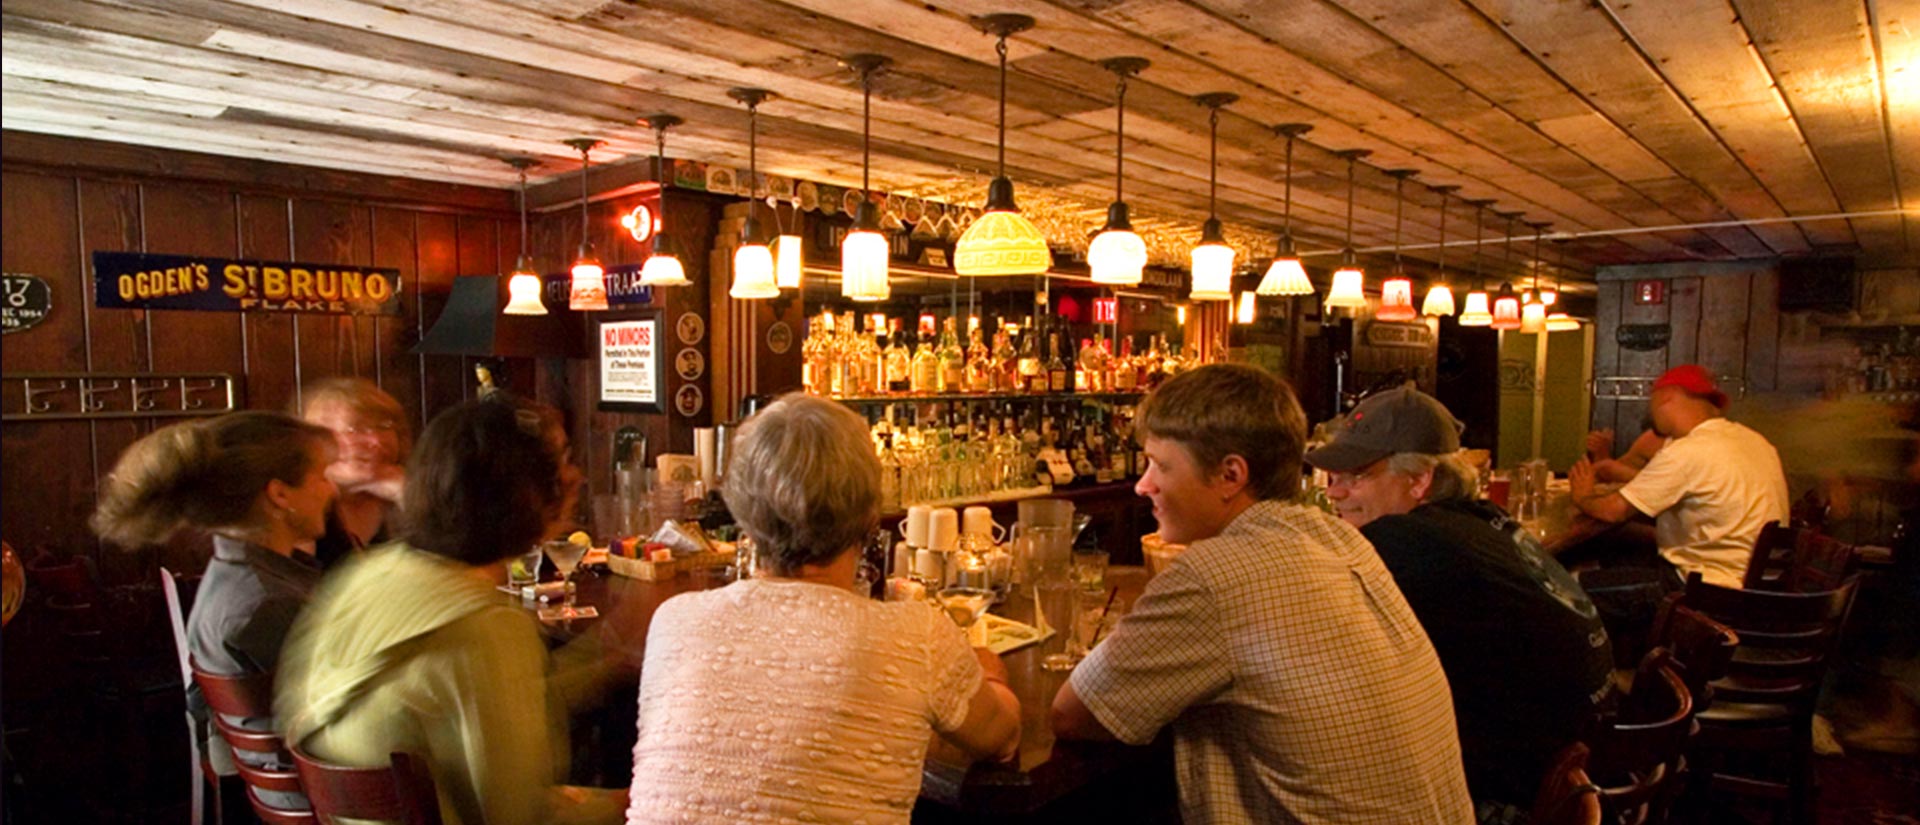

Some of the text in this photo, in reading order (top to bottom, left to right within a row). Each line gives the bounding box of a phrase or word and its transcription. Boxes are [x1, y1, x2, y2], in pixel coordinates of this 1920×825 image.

[119, 262, 208, 301] OGDEN'S
[262, 266, 390, 301] BRUNO
[241, 299, 345, 311] FLAKE
[605, 326, 650, 347] NO MINORS
